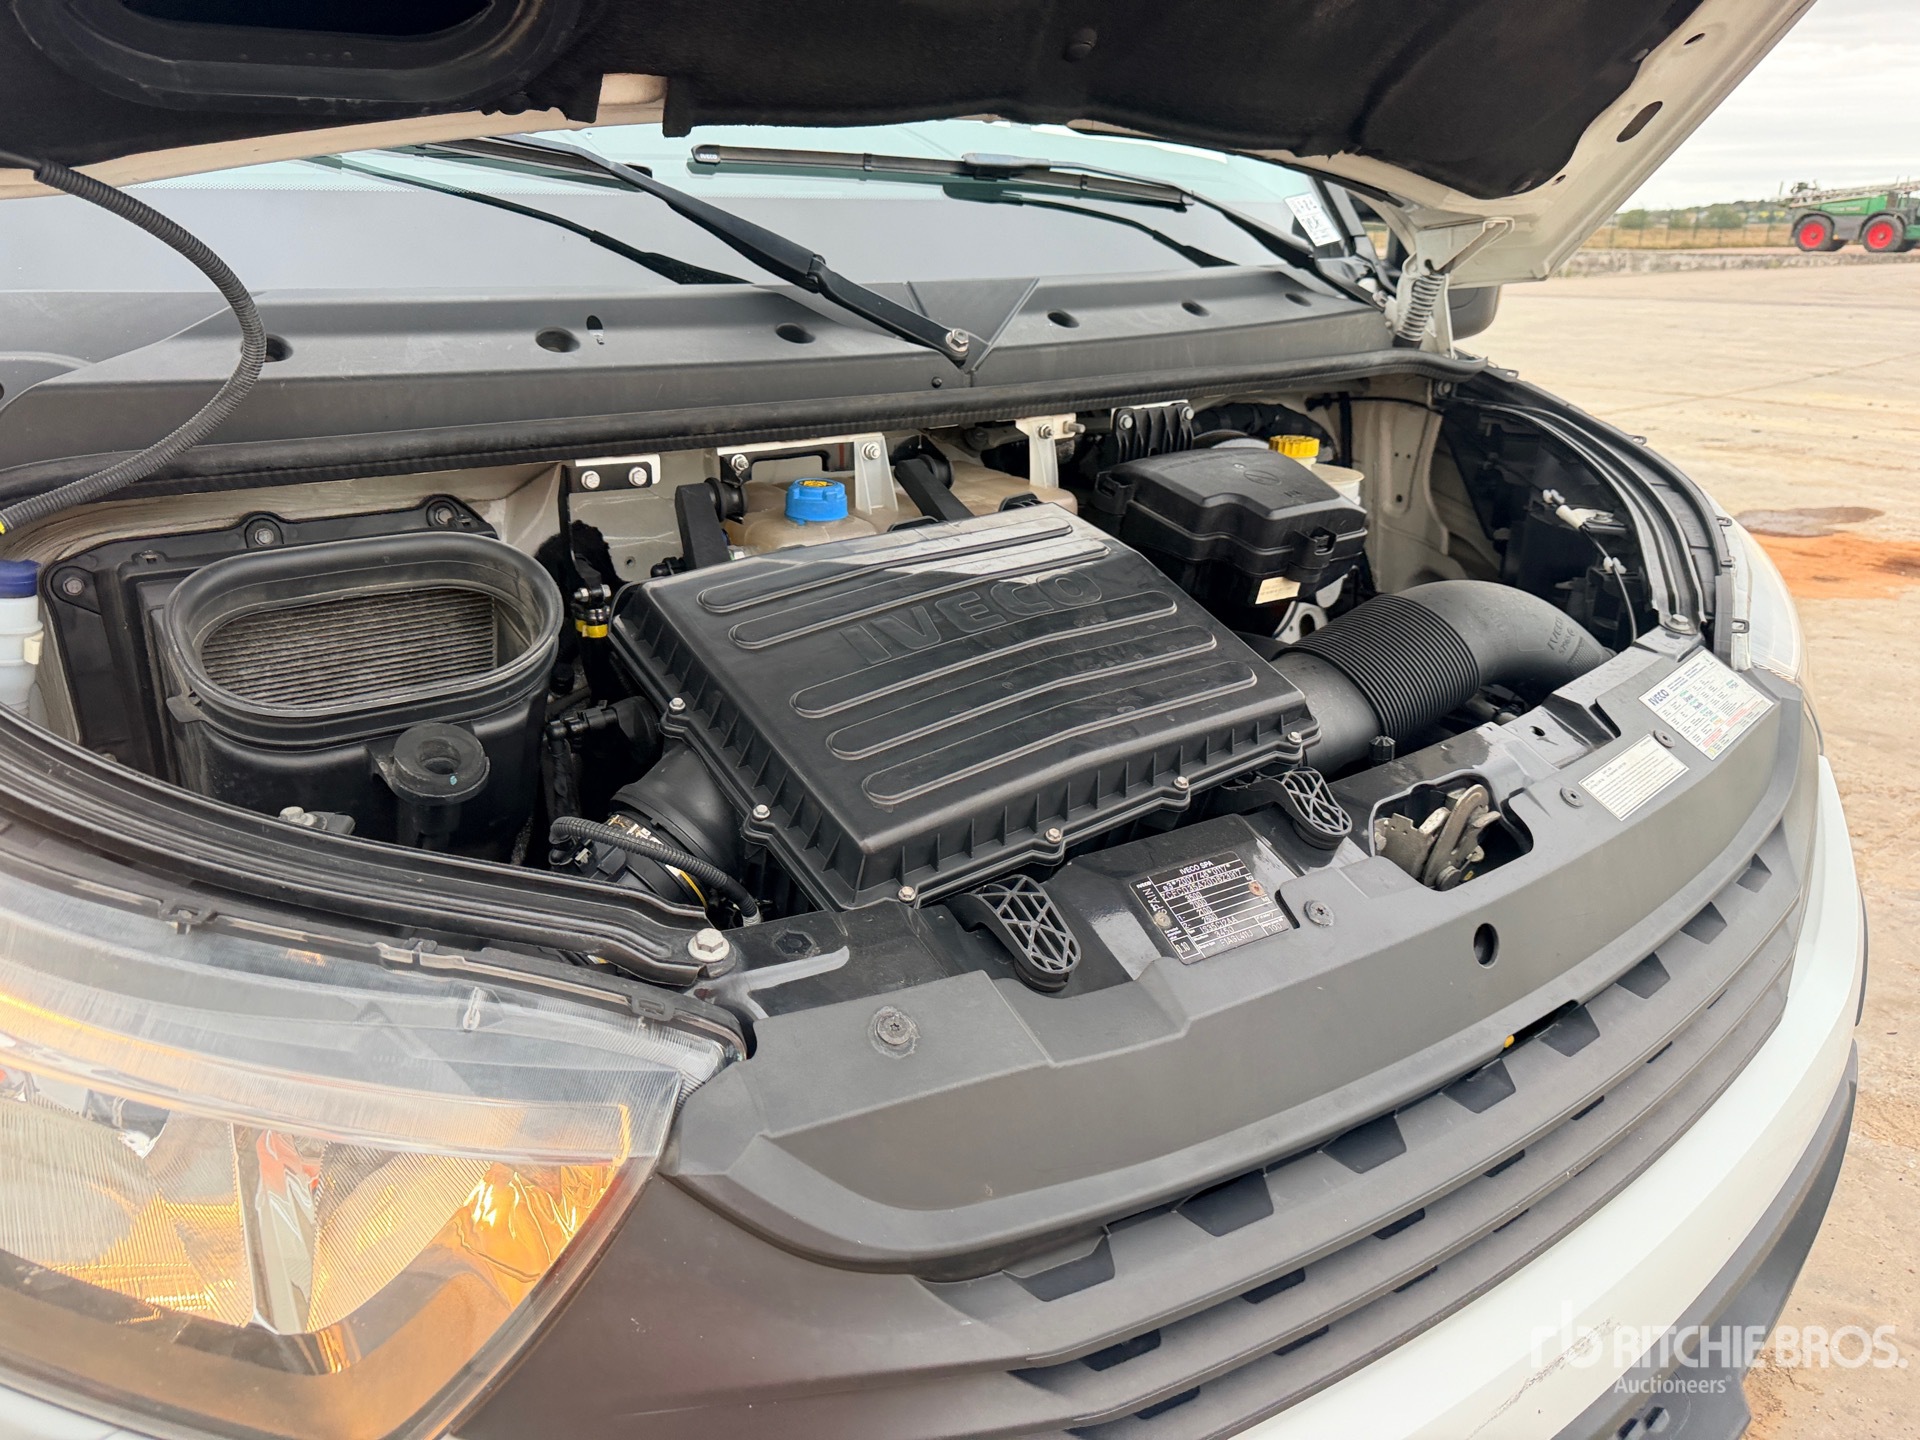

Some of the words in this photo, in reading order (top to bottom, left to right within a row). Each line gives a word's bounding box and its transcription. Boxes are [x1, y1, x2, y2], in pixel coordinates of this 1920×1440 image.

[839, 569, 1102, 666] IVECO
[1648, 689, 1670, 707] IVECO
[1179, 864, 1199, 874] IVECO
[1199, 860, 1214, 868] SPA
[1143, 888, 1168, 915] SPAIN
[1185, 892, 1203, 900] 3500
[1190, 899, 1208, 909] 7000
[1215, 927, 1235, 937] 3450
[1269, 923, 1282, 932] 100
